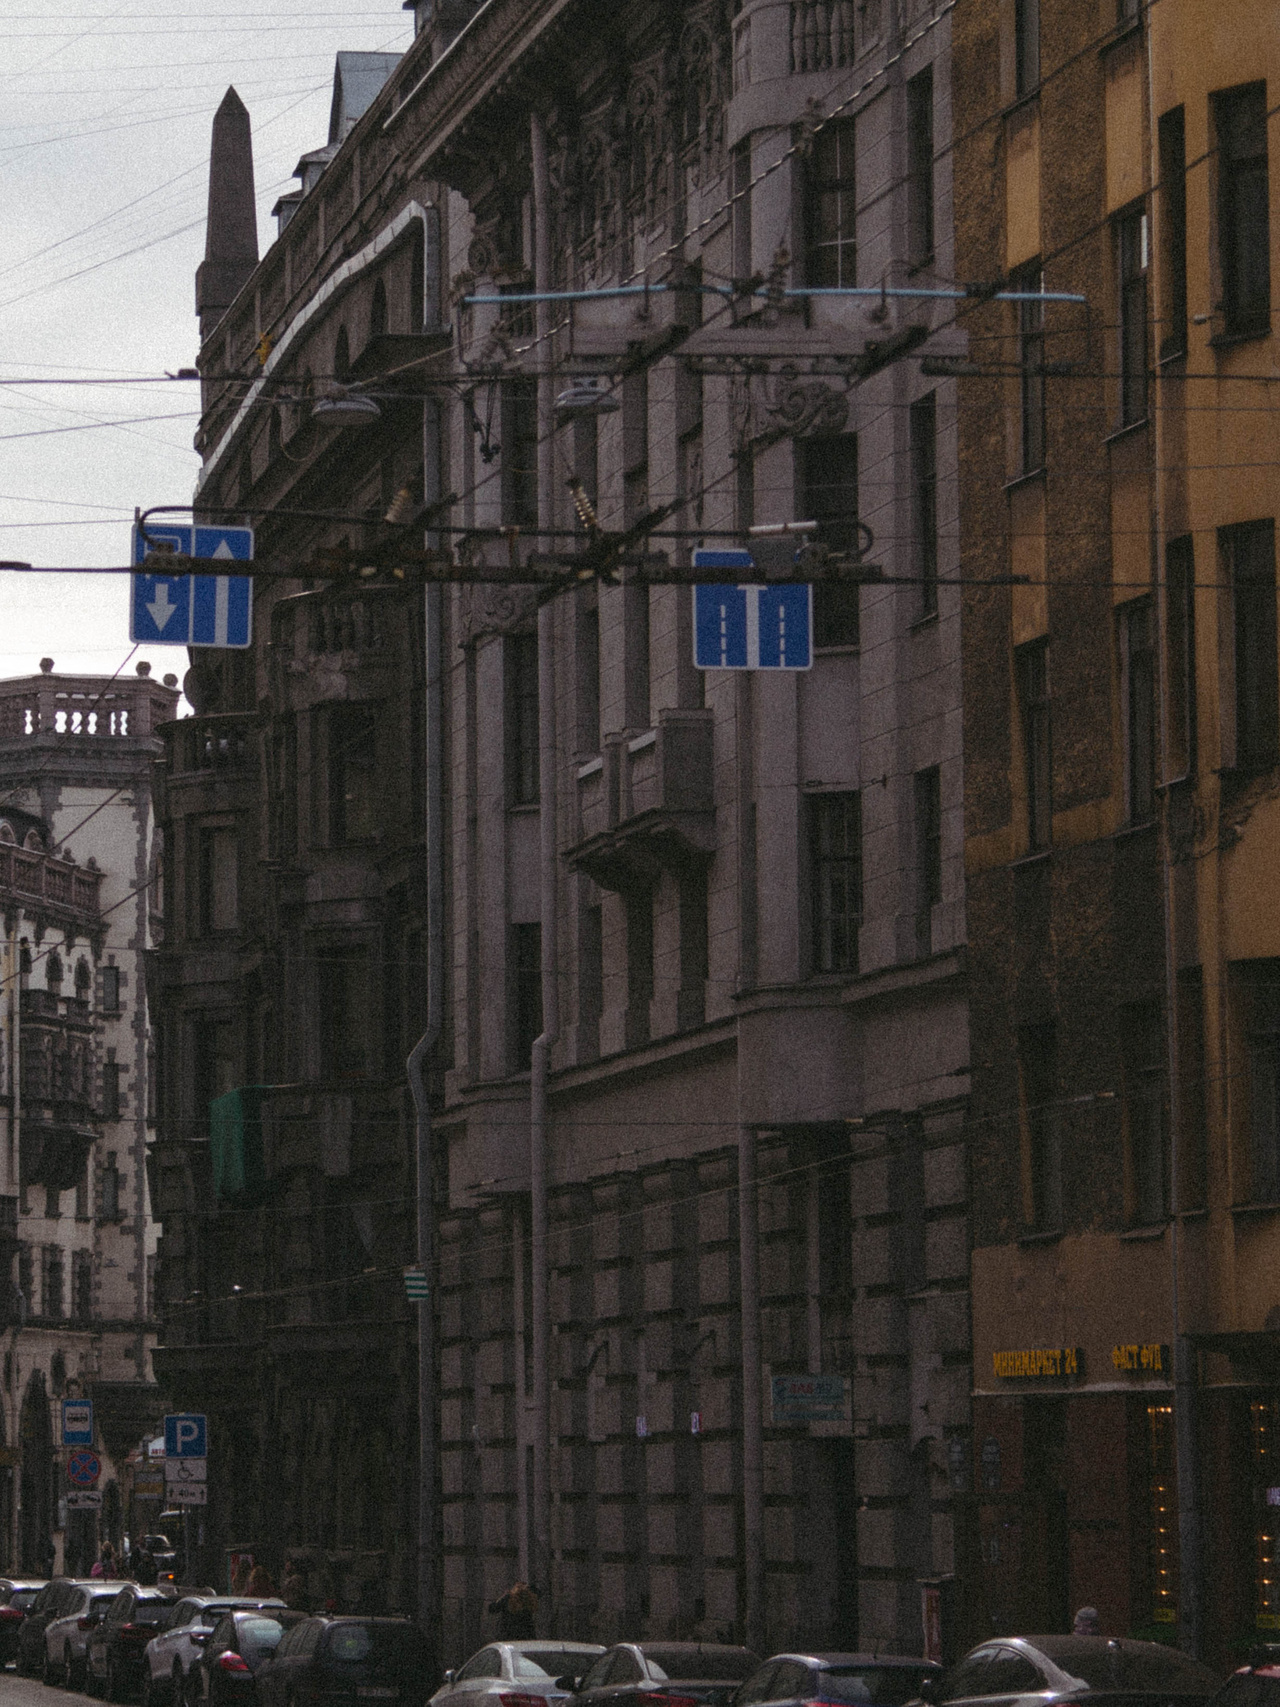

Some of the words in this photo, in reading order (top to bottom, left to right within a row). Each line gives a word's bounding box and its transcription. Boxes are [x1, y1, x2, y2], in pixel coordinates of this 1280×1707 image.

[993, 1350, 1061, 1377] МИНИМАРКЕТ
[1065, 1348, 1077, 1374] 24
[1112, 1344, 1138, 1370] ФАСТ
[1140, 1344, 1163, 1372] ФУД
[176, 1420, 199, 1453] P
